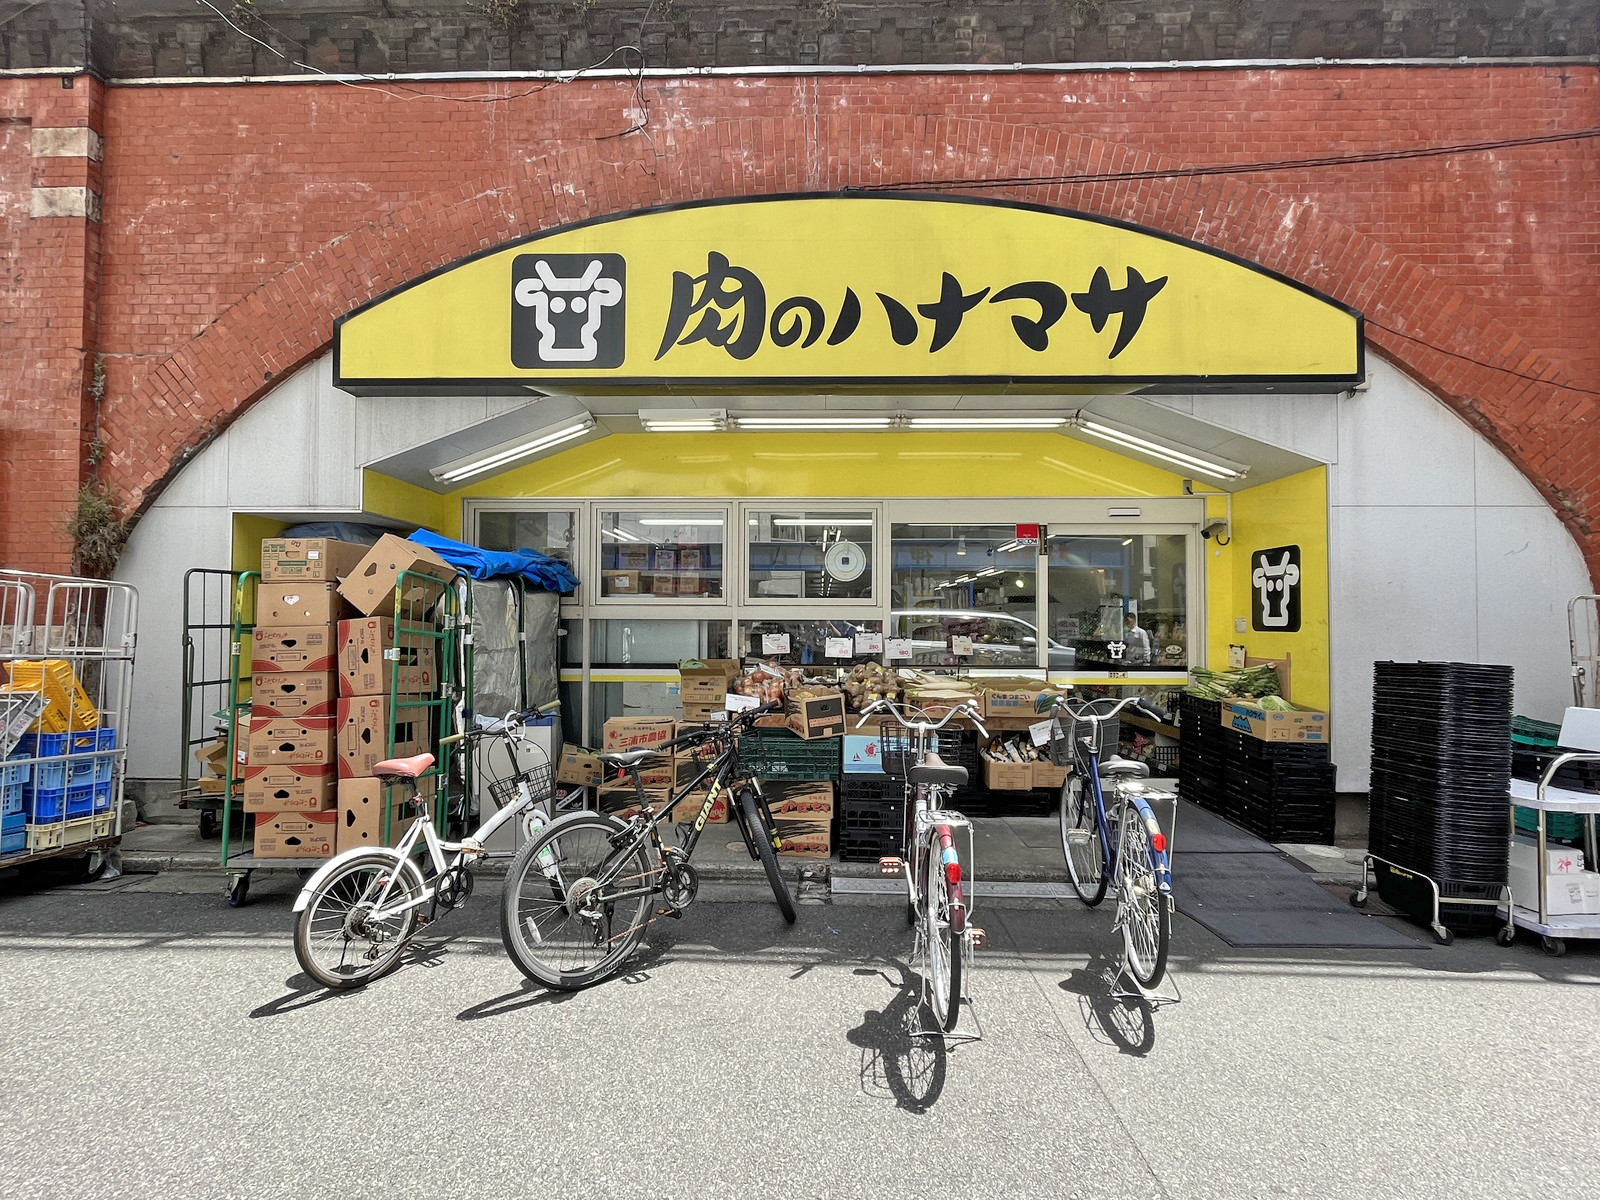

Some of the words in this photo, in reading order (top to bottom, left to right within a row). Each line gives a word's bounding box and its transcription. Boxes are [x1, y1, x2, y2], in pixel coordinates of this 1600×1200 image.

[655, 251, 1168, 360] 肉のハナマサ
[619, 730, 667, 748] 三浦市農協
[695, 779, 721, 831] GIANT
